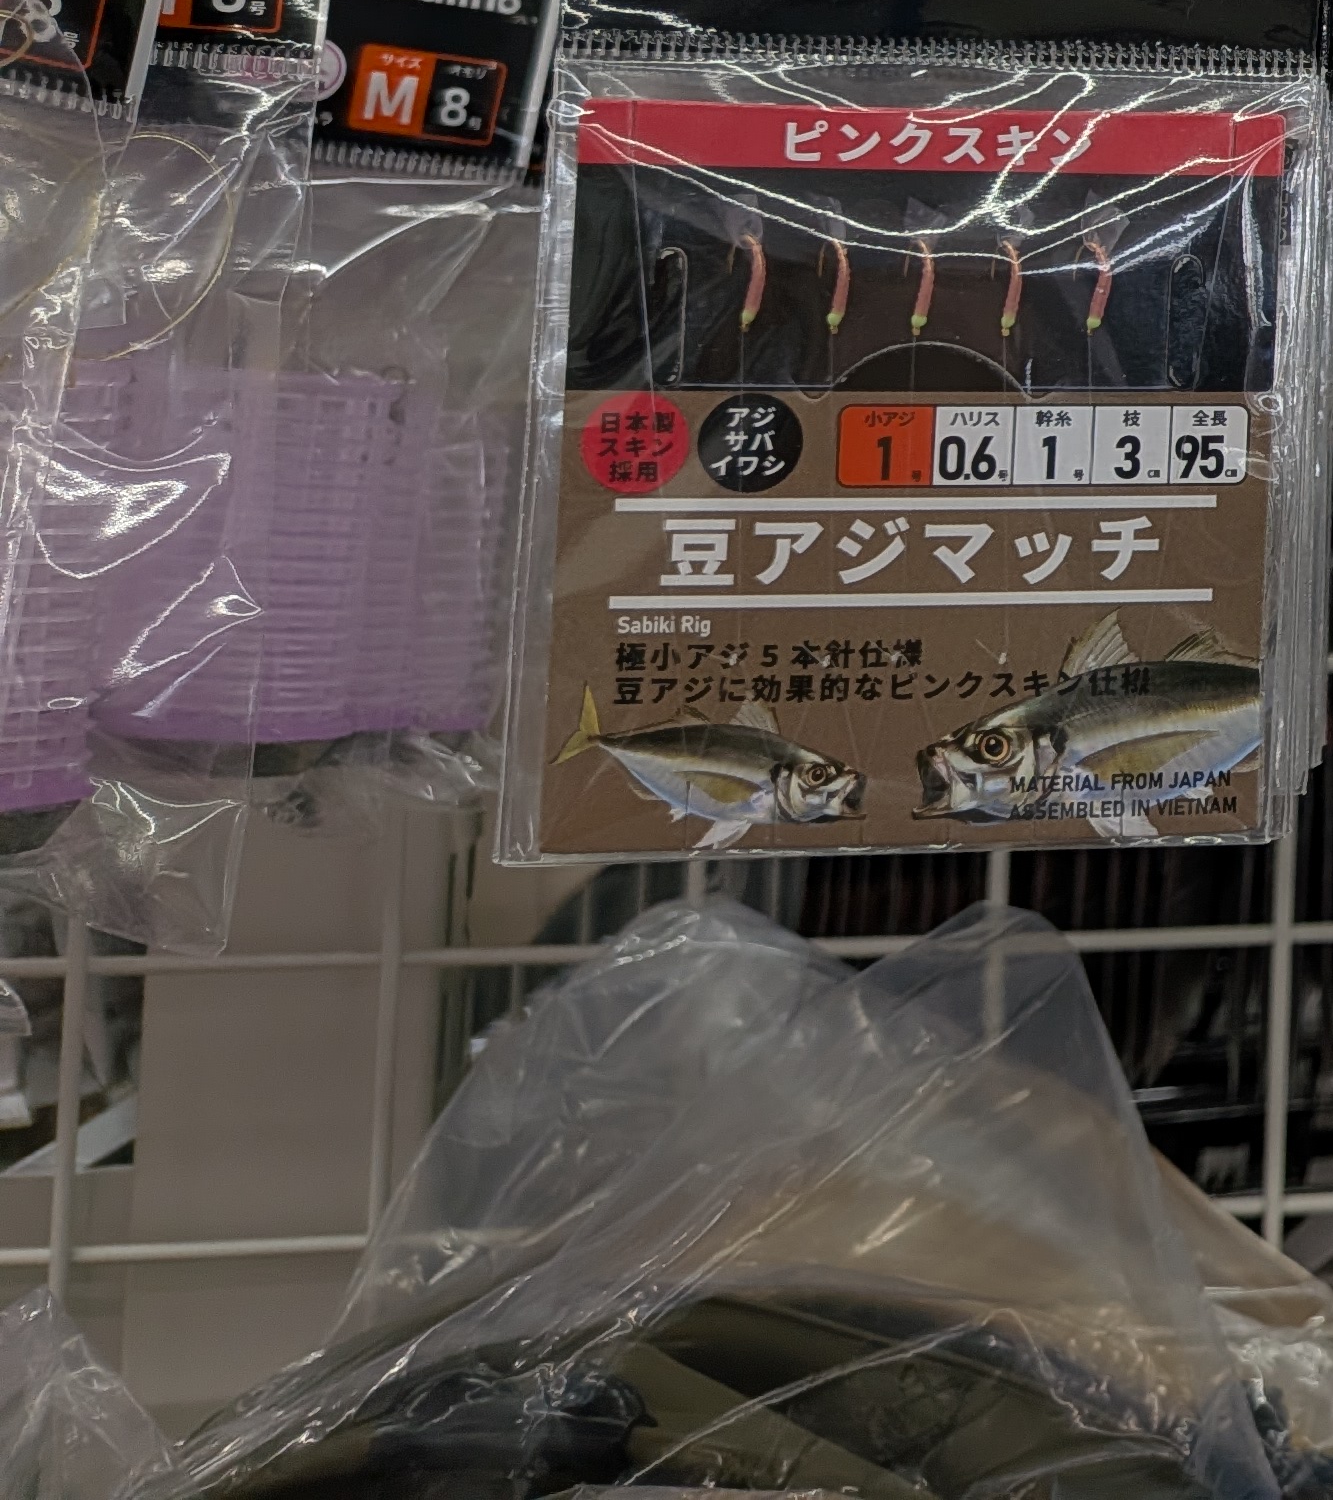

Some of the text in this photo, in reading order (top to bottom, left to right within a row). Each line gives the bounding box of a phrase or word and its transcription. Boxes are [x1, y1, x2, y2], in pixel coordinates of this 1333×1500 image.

[362, 71, 471, 128] M 8
[784, 120, 1093, 166] ピンクスキン
[600, 411, 676, 438] 日本製
[724, 406, 776, 429] アジ
[864, 408, 1229, 430] 小アジ ハリス 幹糸 枝 全長
[596, 436, 674, 460] スキン
[723, 429, 776, 453] サバ
[608, 459, 659, 483] 採用
[708, 453, 786, 478] イワシ
[877, 434, 1224, 483] 1 0.6 1 3 95
[660, 514, 1163, 587] 豆アジマッチ
[617, 615, 712, 638] Sabiki Rig
[1009, 769, 1233, 794] MATERIAL FROM JAPAN
[1009, 796, 1238, 822] ASSEMBLED IN VIETNAM
